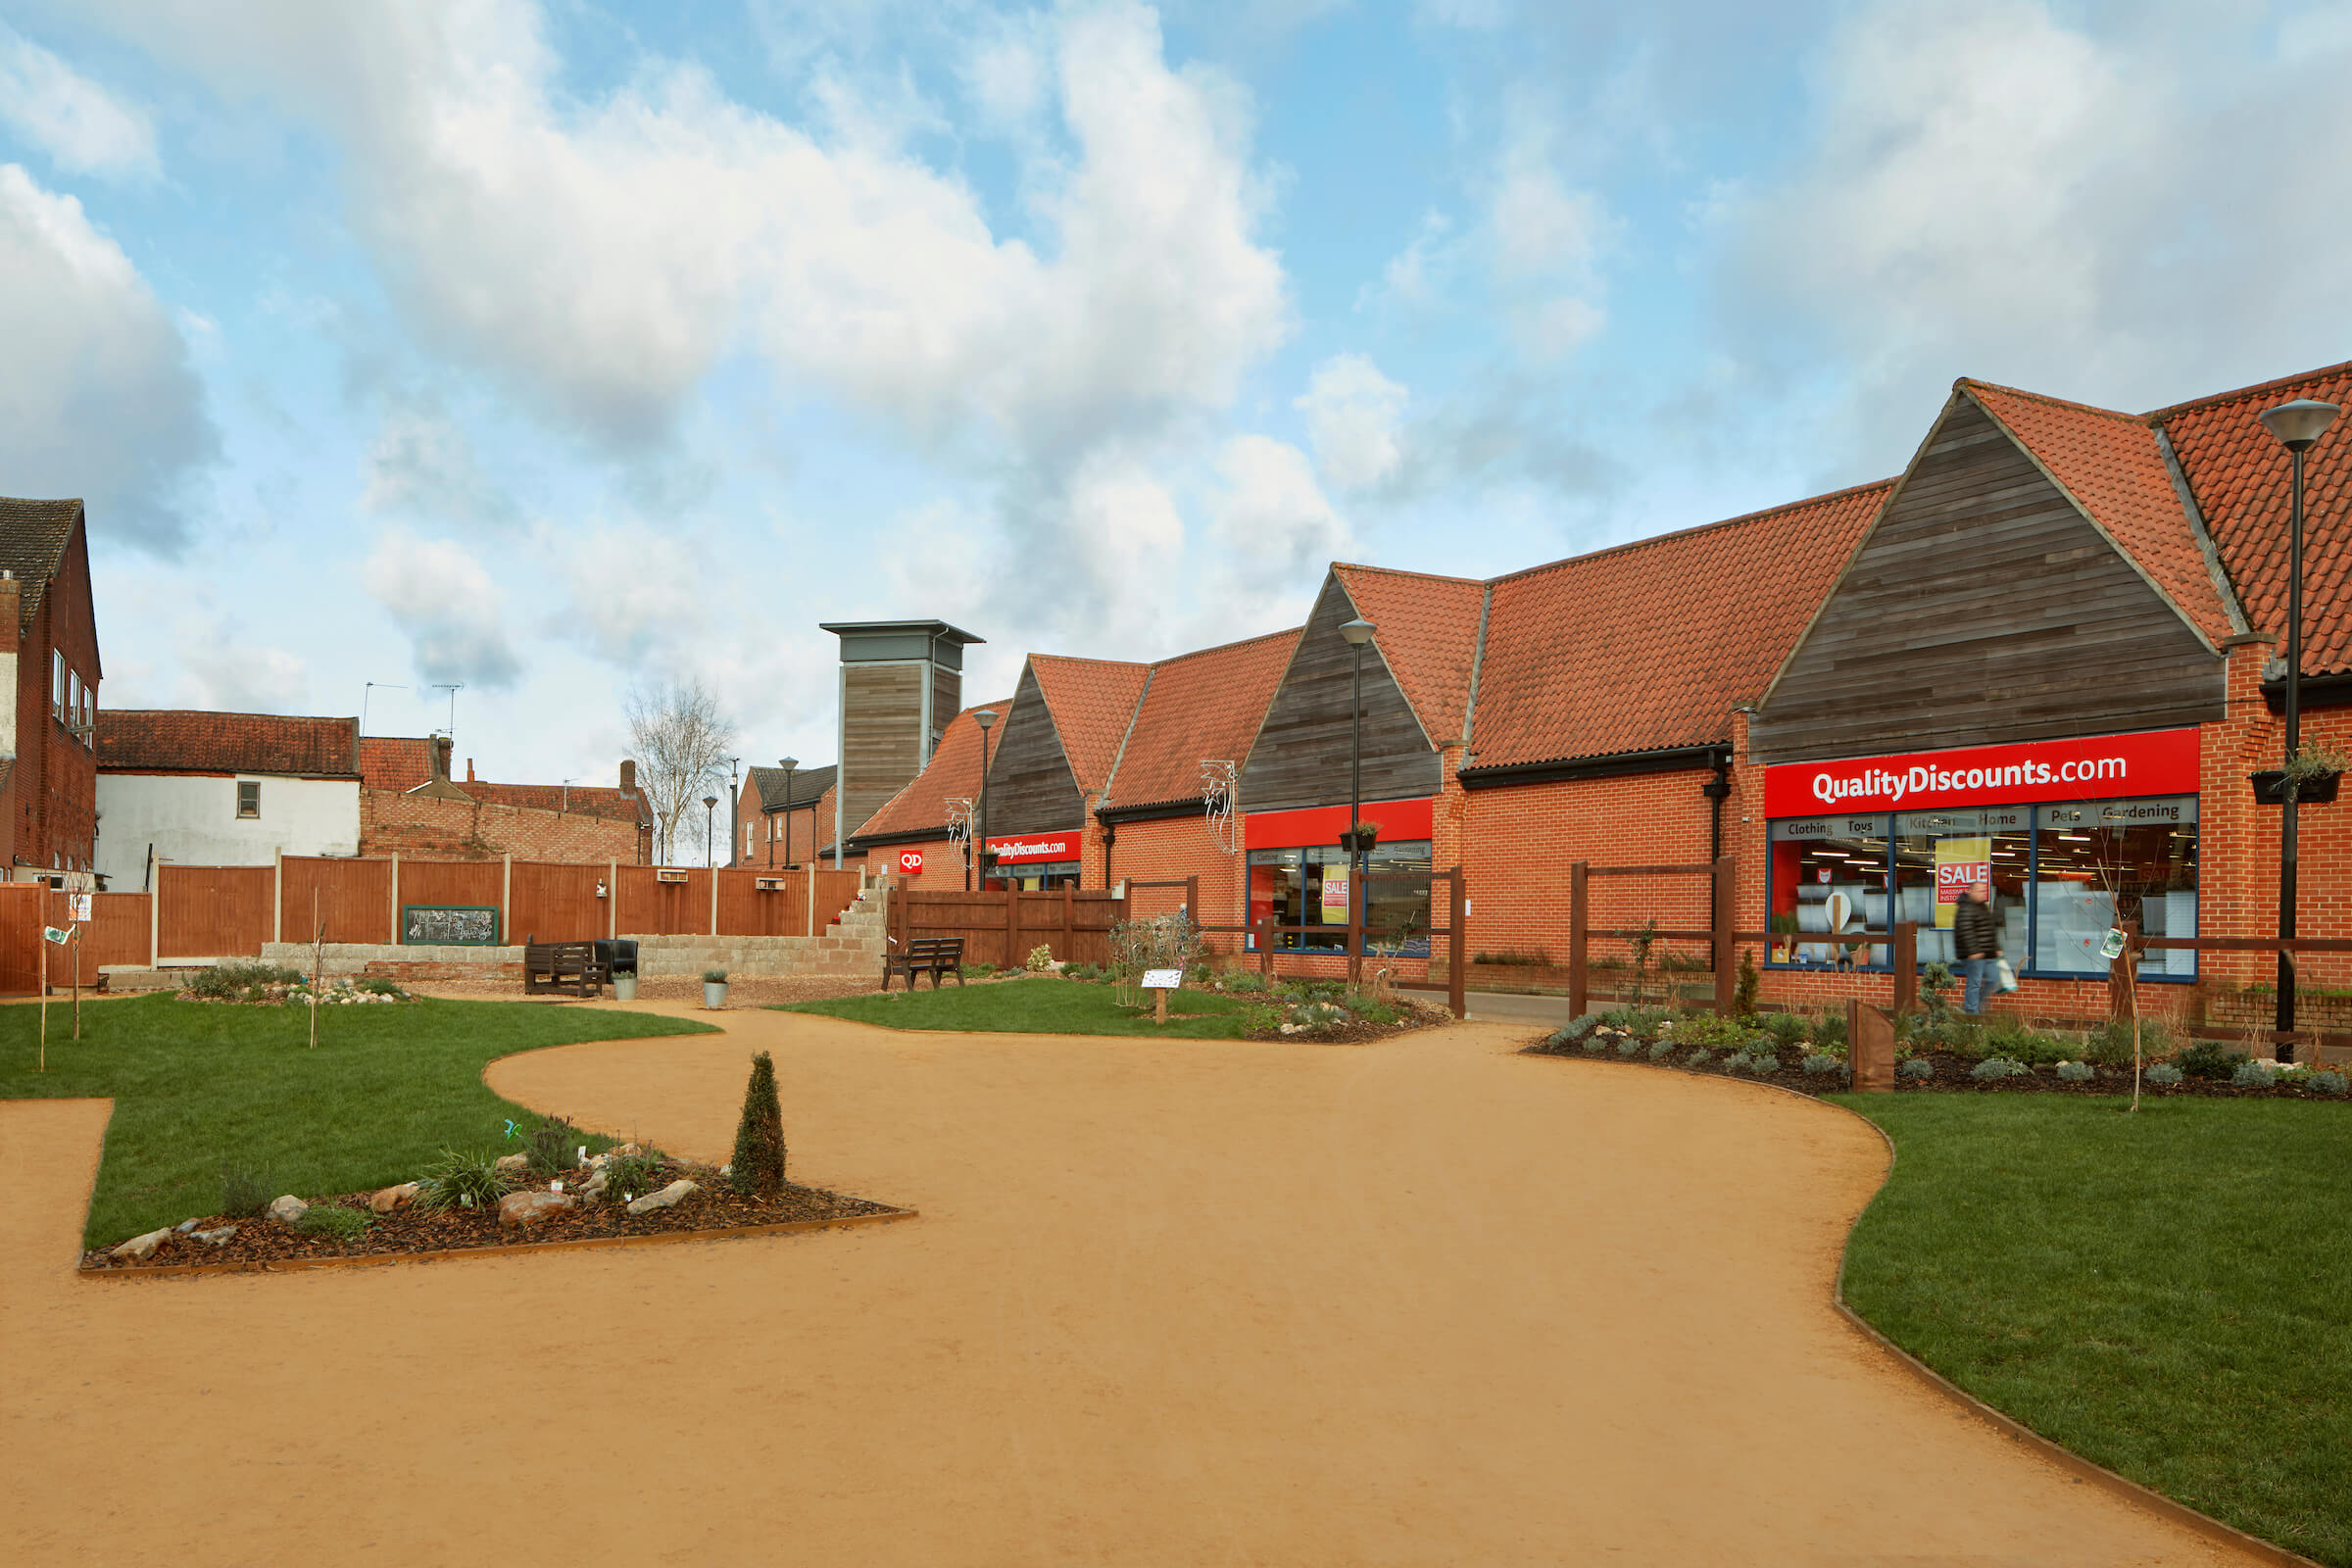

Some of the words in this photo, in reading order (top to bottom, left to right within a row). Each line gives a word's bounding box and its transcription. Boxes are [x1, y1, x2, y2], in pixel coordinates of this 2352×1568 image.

[1813, 757, 2127, 805] QualityDiscounts.com
[1788, 823, 1833, 837] Clothing
[1848, 820, 1873, 833] Toys
[1910, 815, 1956, 829] Kitchen
[1979, 813, 2016, 825] Home
[2052, 809, 2081, 822] Pets
[2102, 804, 2180, 820] Gardening
[991, 841, 1066, 859] QualityDiscounts.com
[901, 854, 922, 869] QD
[1939, 865, 1987, 884] SALE
[1325, 882, 1348, 895] SALE
